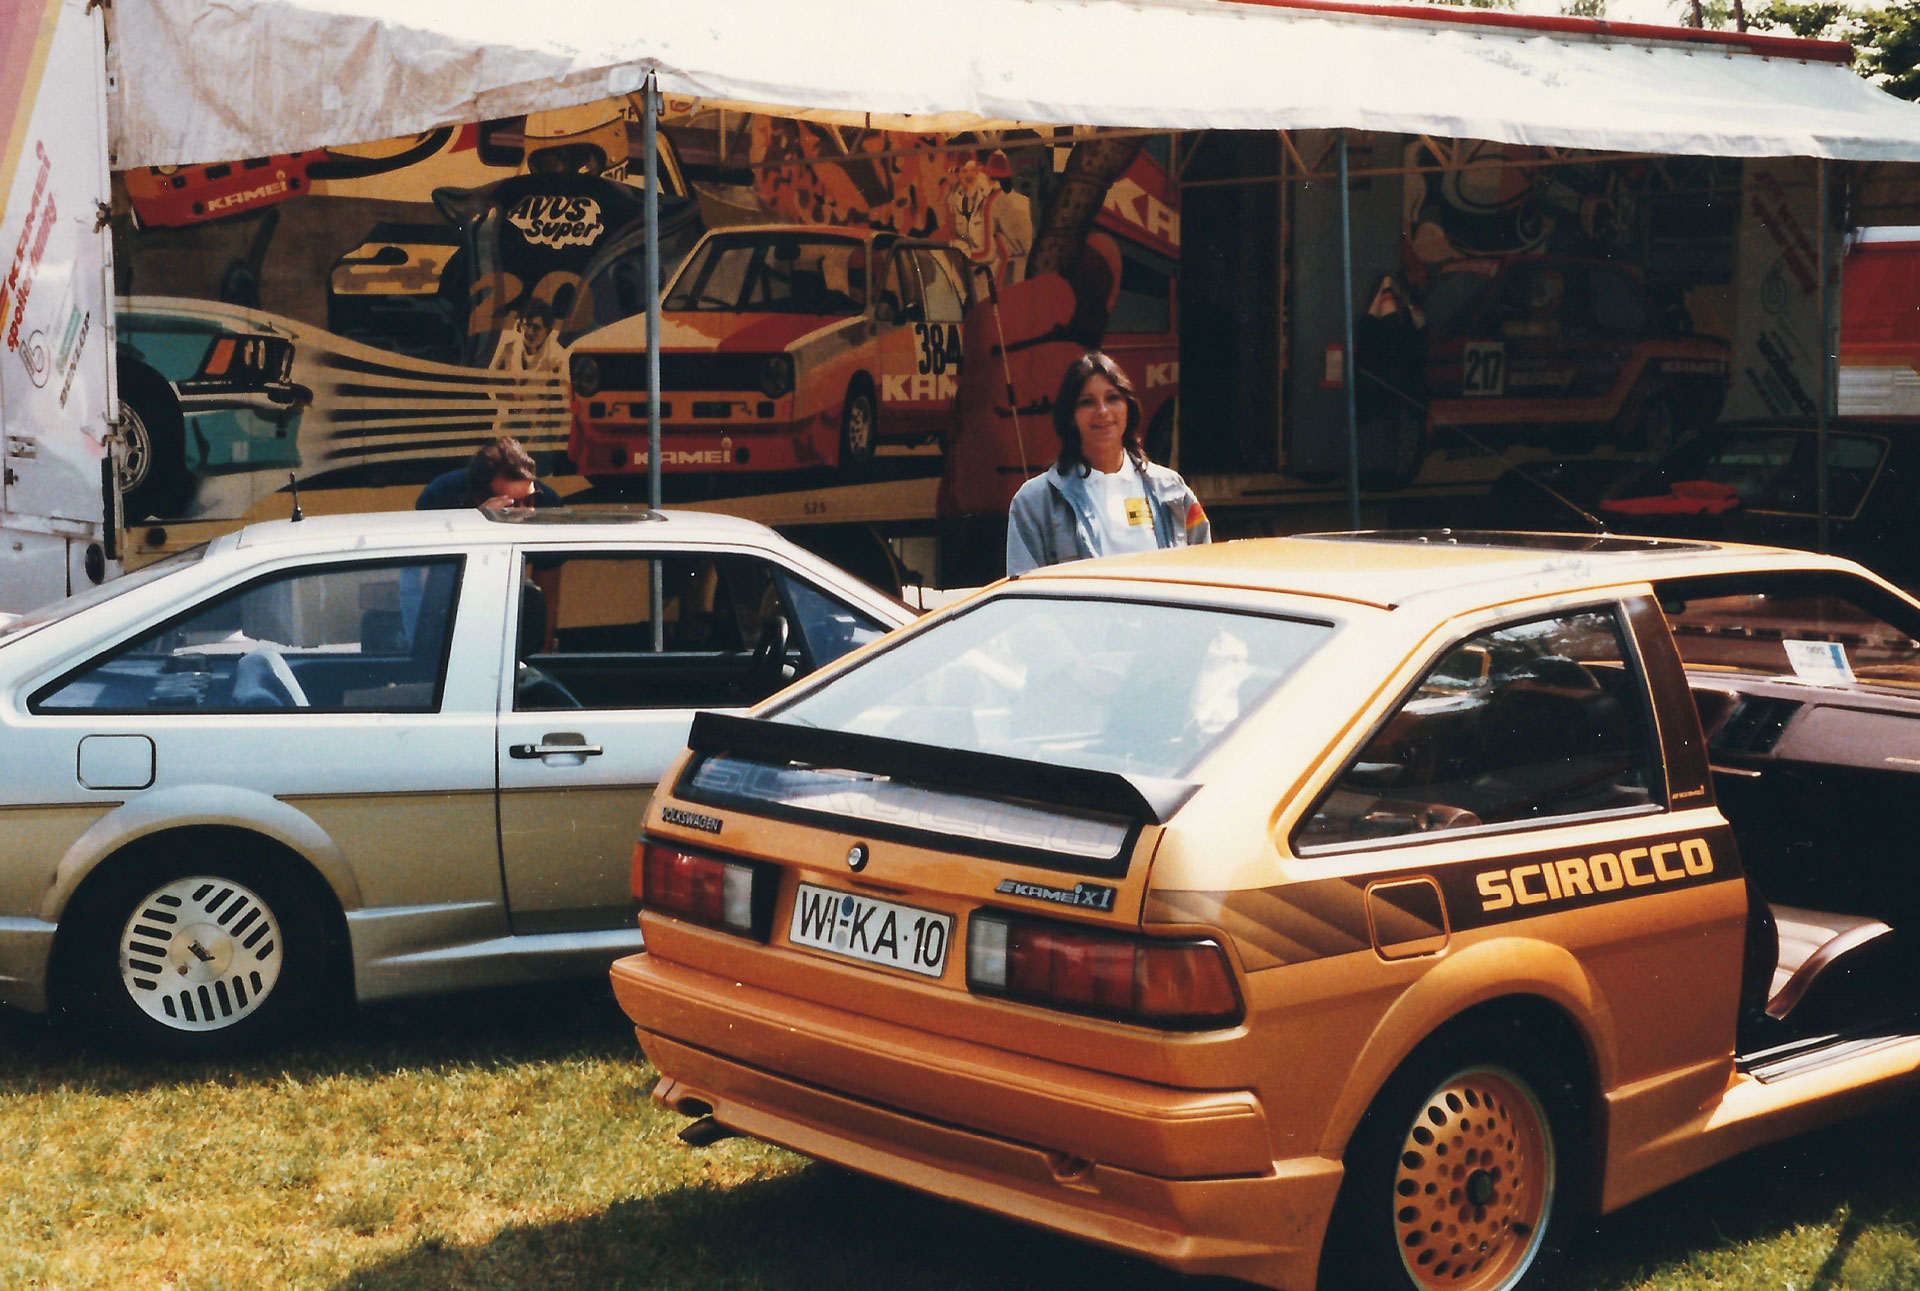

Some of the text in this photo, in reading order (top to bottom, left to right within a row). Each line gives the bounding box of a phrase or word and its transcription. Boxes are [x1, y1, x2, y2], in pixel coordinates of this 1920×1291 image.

[508, 196, 593, 222] AVUS
[915, 323, 963, 376] 384
[1466, 350, 1503, 390] 217
[661, 806, 721, 831] VOLKSWAGEN
[1475, 838, 1715, 912] SCIROCCO
